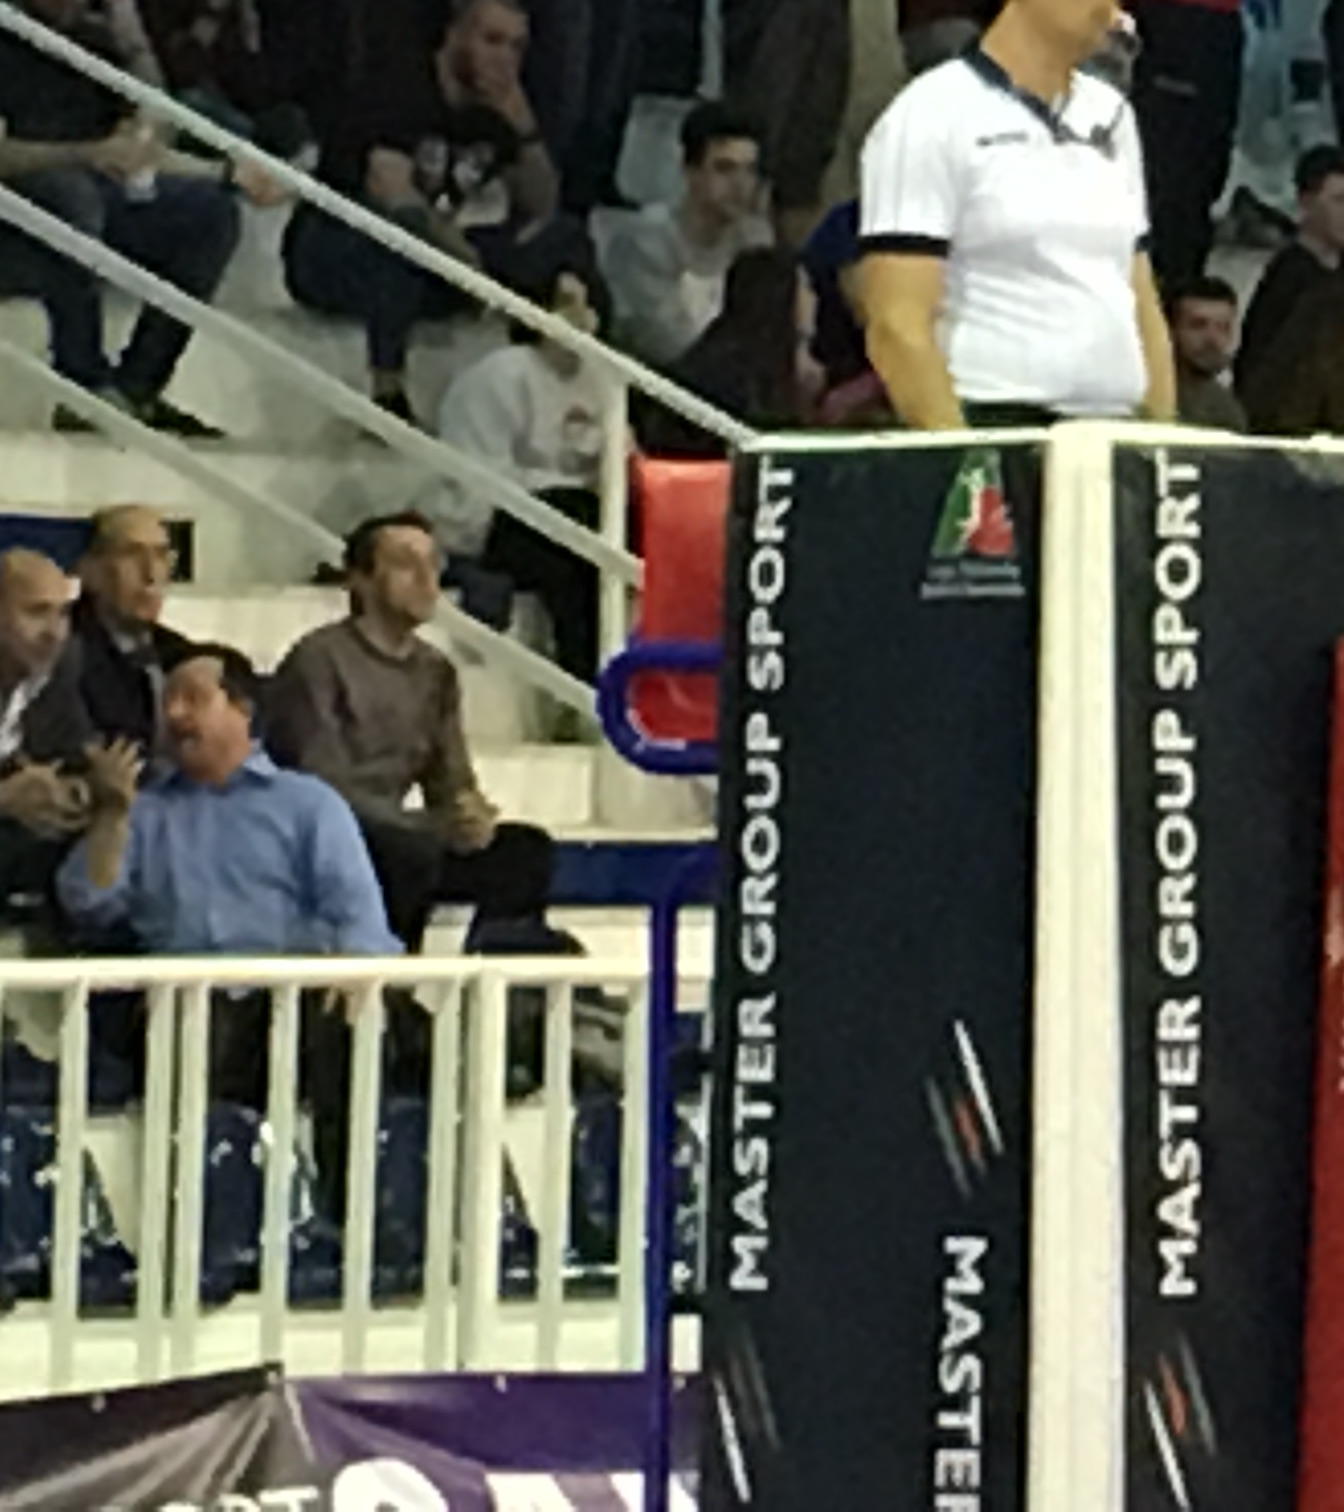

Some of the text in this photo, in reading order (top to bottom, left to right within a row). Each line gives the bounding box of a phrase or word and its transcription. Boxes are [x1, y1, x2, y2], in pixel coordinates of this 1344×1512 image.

[729, 454, 794, 1291] MASTER GROUP SPORT
[1153, 450, 1202, 1295] MASTER GROUP SPORT
